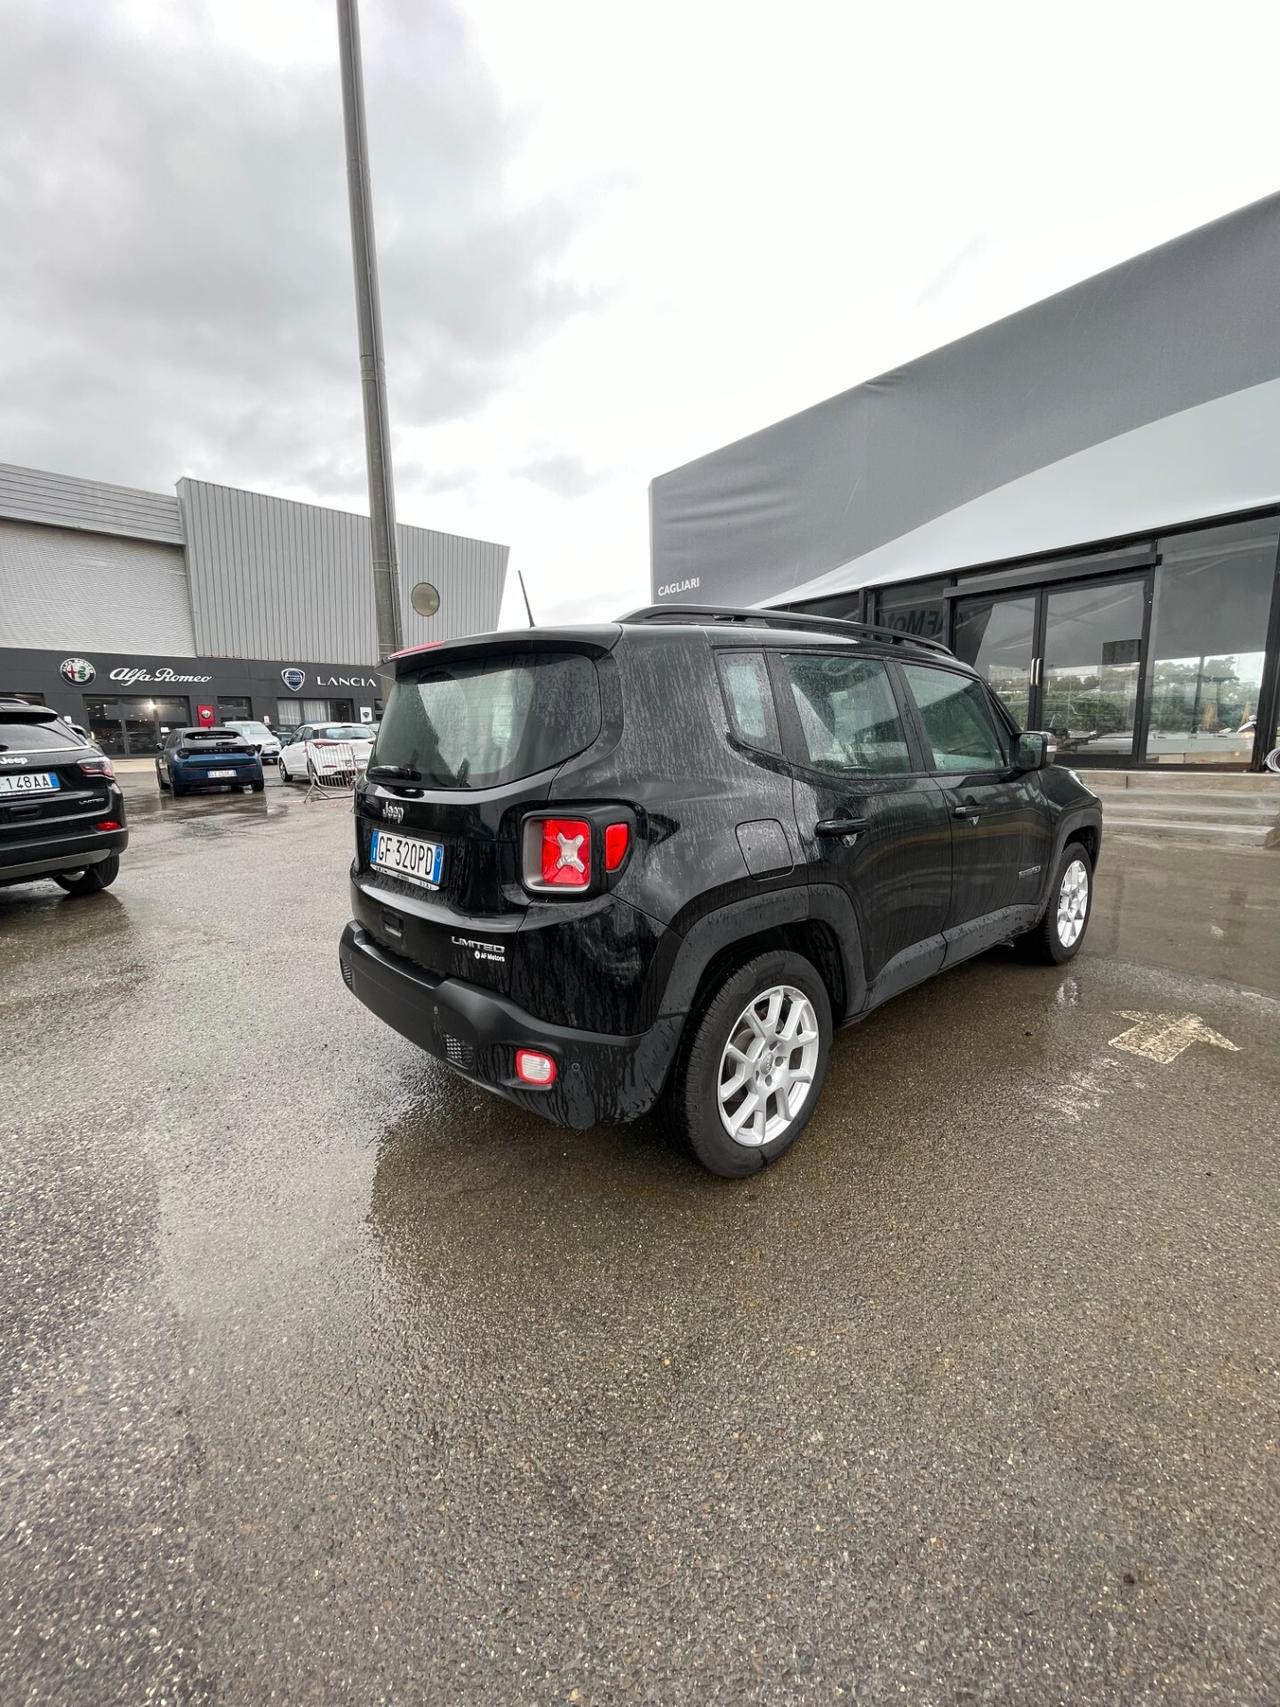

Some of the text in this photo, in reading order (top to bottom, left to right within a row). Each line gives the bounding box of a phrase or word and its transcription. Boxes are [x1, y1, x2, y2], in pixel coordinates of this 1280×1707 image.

[658, 577, 700, 596] CAGLIARI
[109, 667, 153, 686] Alfa
[153, 667, 213, 683] Romeo
[316, 676, 377, 687] LANCIA
[0, 757, 28, 765] Jeep
[6, 774, 51, 790] 148AA
[382, 801, 405, 824] Jeep
[378, 835, 434, 876] GF 320PD
[451, 935, 505, 954] LIMITED
[480, 952, 505, 962] AF Motors
